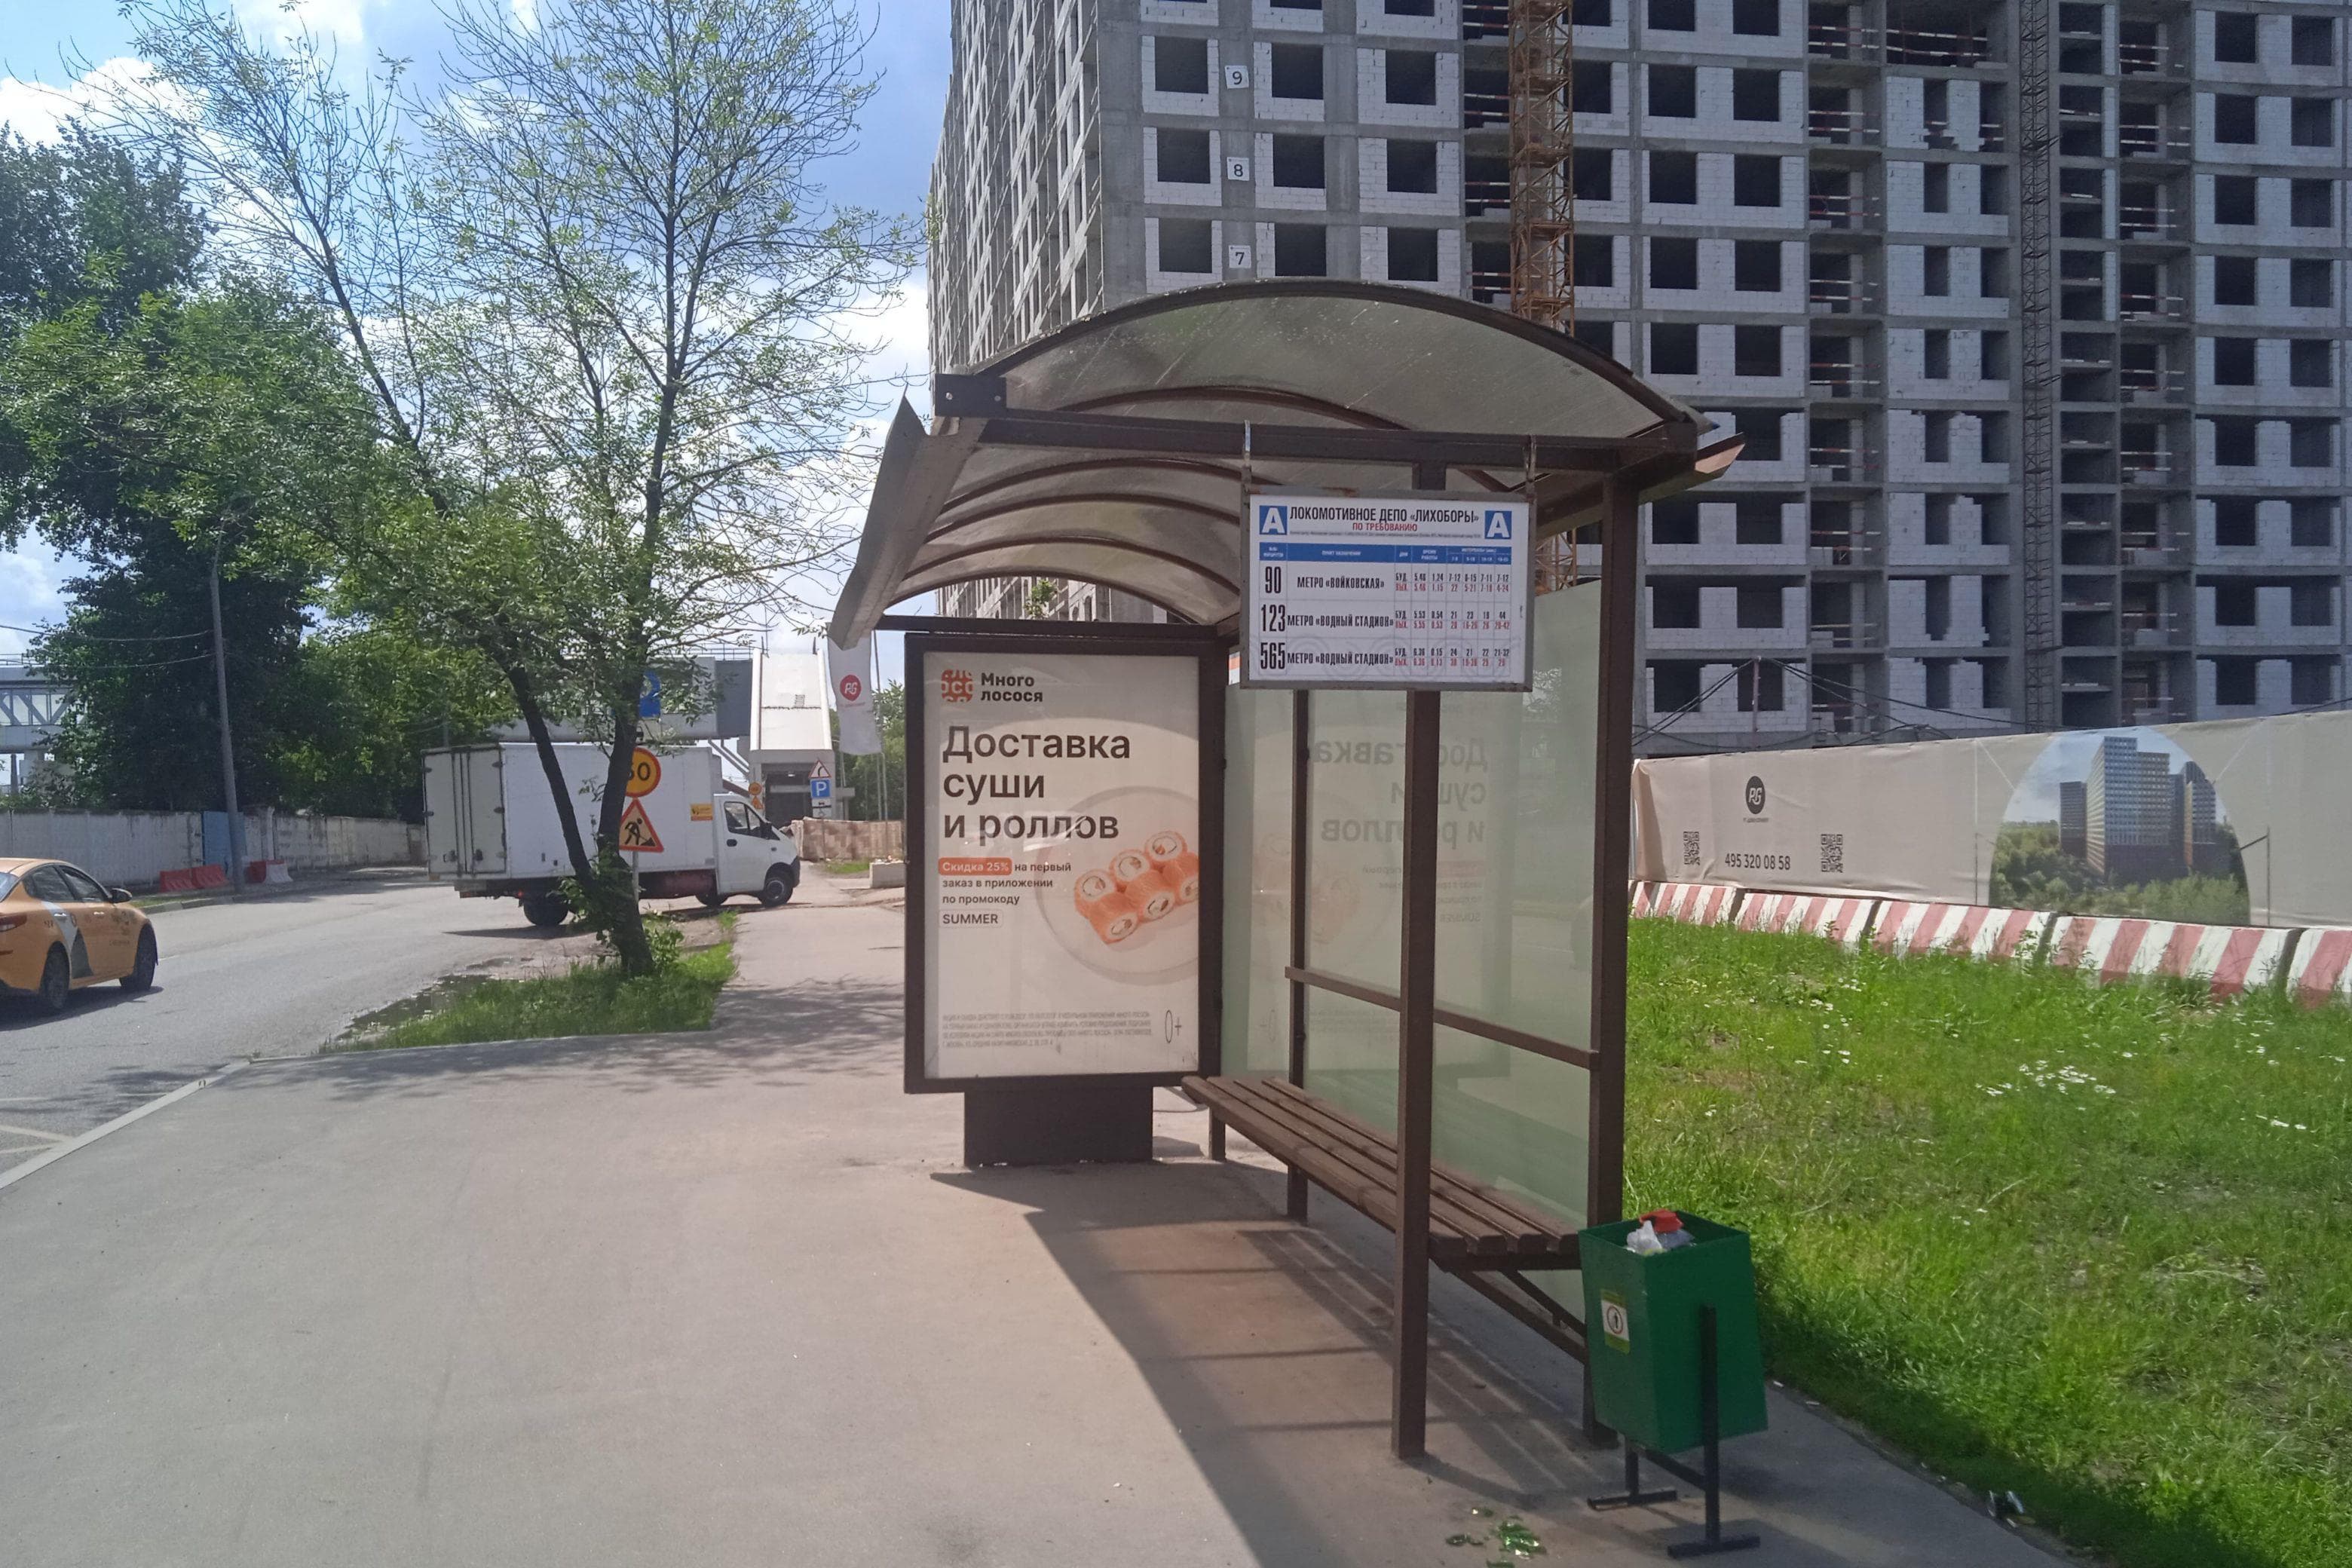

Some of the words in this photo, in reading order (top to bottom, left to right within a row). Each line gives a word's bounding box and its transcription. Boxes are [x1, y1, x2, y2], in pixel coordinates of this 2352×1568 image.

[1232, 71, 1243, 85] 9
[1233, 164, 1244, 177] 8
[1235, 252, 1245, 265] 7
[1290, 506, 1377, 521] ЛОКОМОТИВНОЕ
[1379, 508, 1407, 523] ДЕПО
[1410, 509, 1479, 523] «ЛИХОБОРЫ»
[1352, 522, 1363, 531] ПО
[1365, 522, 1418, 531] ТРЕБОВАНИЮ
[1265, 566, 1281, 594] 90
[1297, 577, 1324, 588] МЕТРО
[1325, 575, 1385, 589] «ВОЙКОВСКАЯ»
[1260, 604, 1285, 632] 123
[1288, 614, 1313, 626] МЕТРО
[1315, 614, 1353, 628] «ВОДНЫЙ
[1355, 615, 1394, 629] СТАДИОН»
[1260, 642, 1286, 669] 565
[1288, 652, 1313, 664] МЕТРО
[1315, 651, 1353, 666] «ВОДНЫЙ
[1355, 653, 1394, 666] СТАДИОН»
[981, 672, 1035, 687] Много
[980, 691, 1043, 702] лосося
[942, 725, 1131, 764] Доставка
[943, 773, 1045, 805] суши
[1748, 787, 1762, 805] PG
[944, 814, 966, 838] и
[979, 815, 1119, 847] роллов
[942, 862, 984, 873] Скидка
[987, 862, 1009, 871] 25%
[1030, 862, 1071, 873] первый
[1725, 853, 1741, 868] 495
[1744, 854, 1761, 868] 320
[1763, 855, 1775, 870] 08
[1778, 856, 1790, 870] 58
[985, 880, 1053, 889] приложении
[958, 896, 1020, 905] промокоду
[942, 914, 999, 924] SUMMER
[1165, 1009, 1182, 1044] 0+
